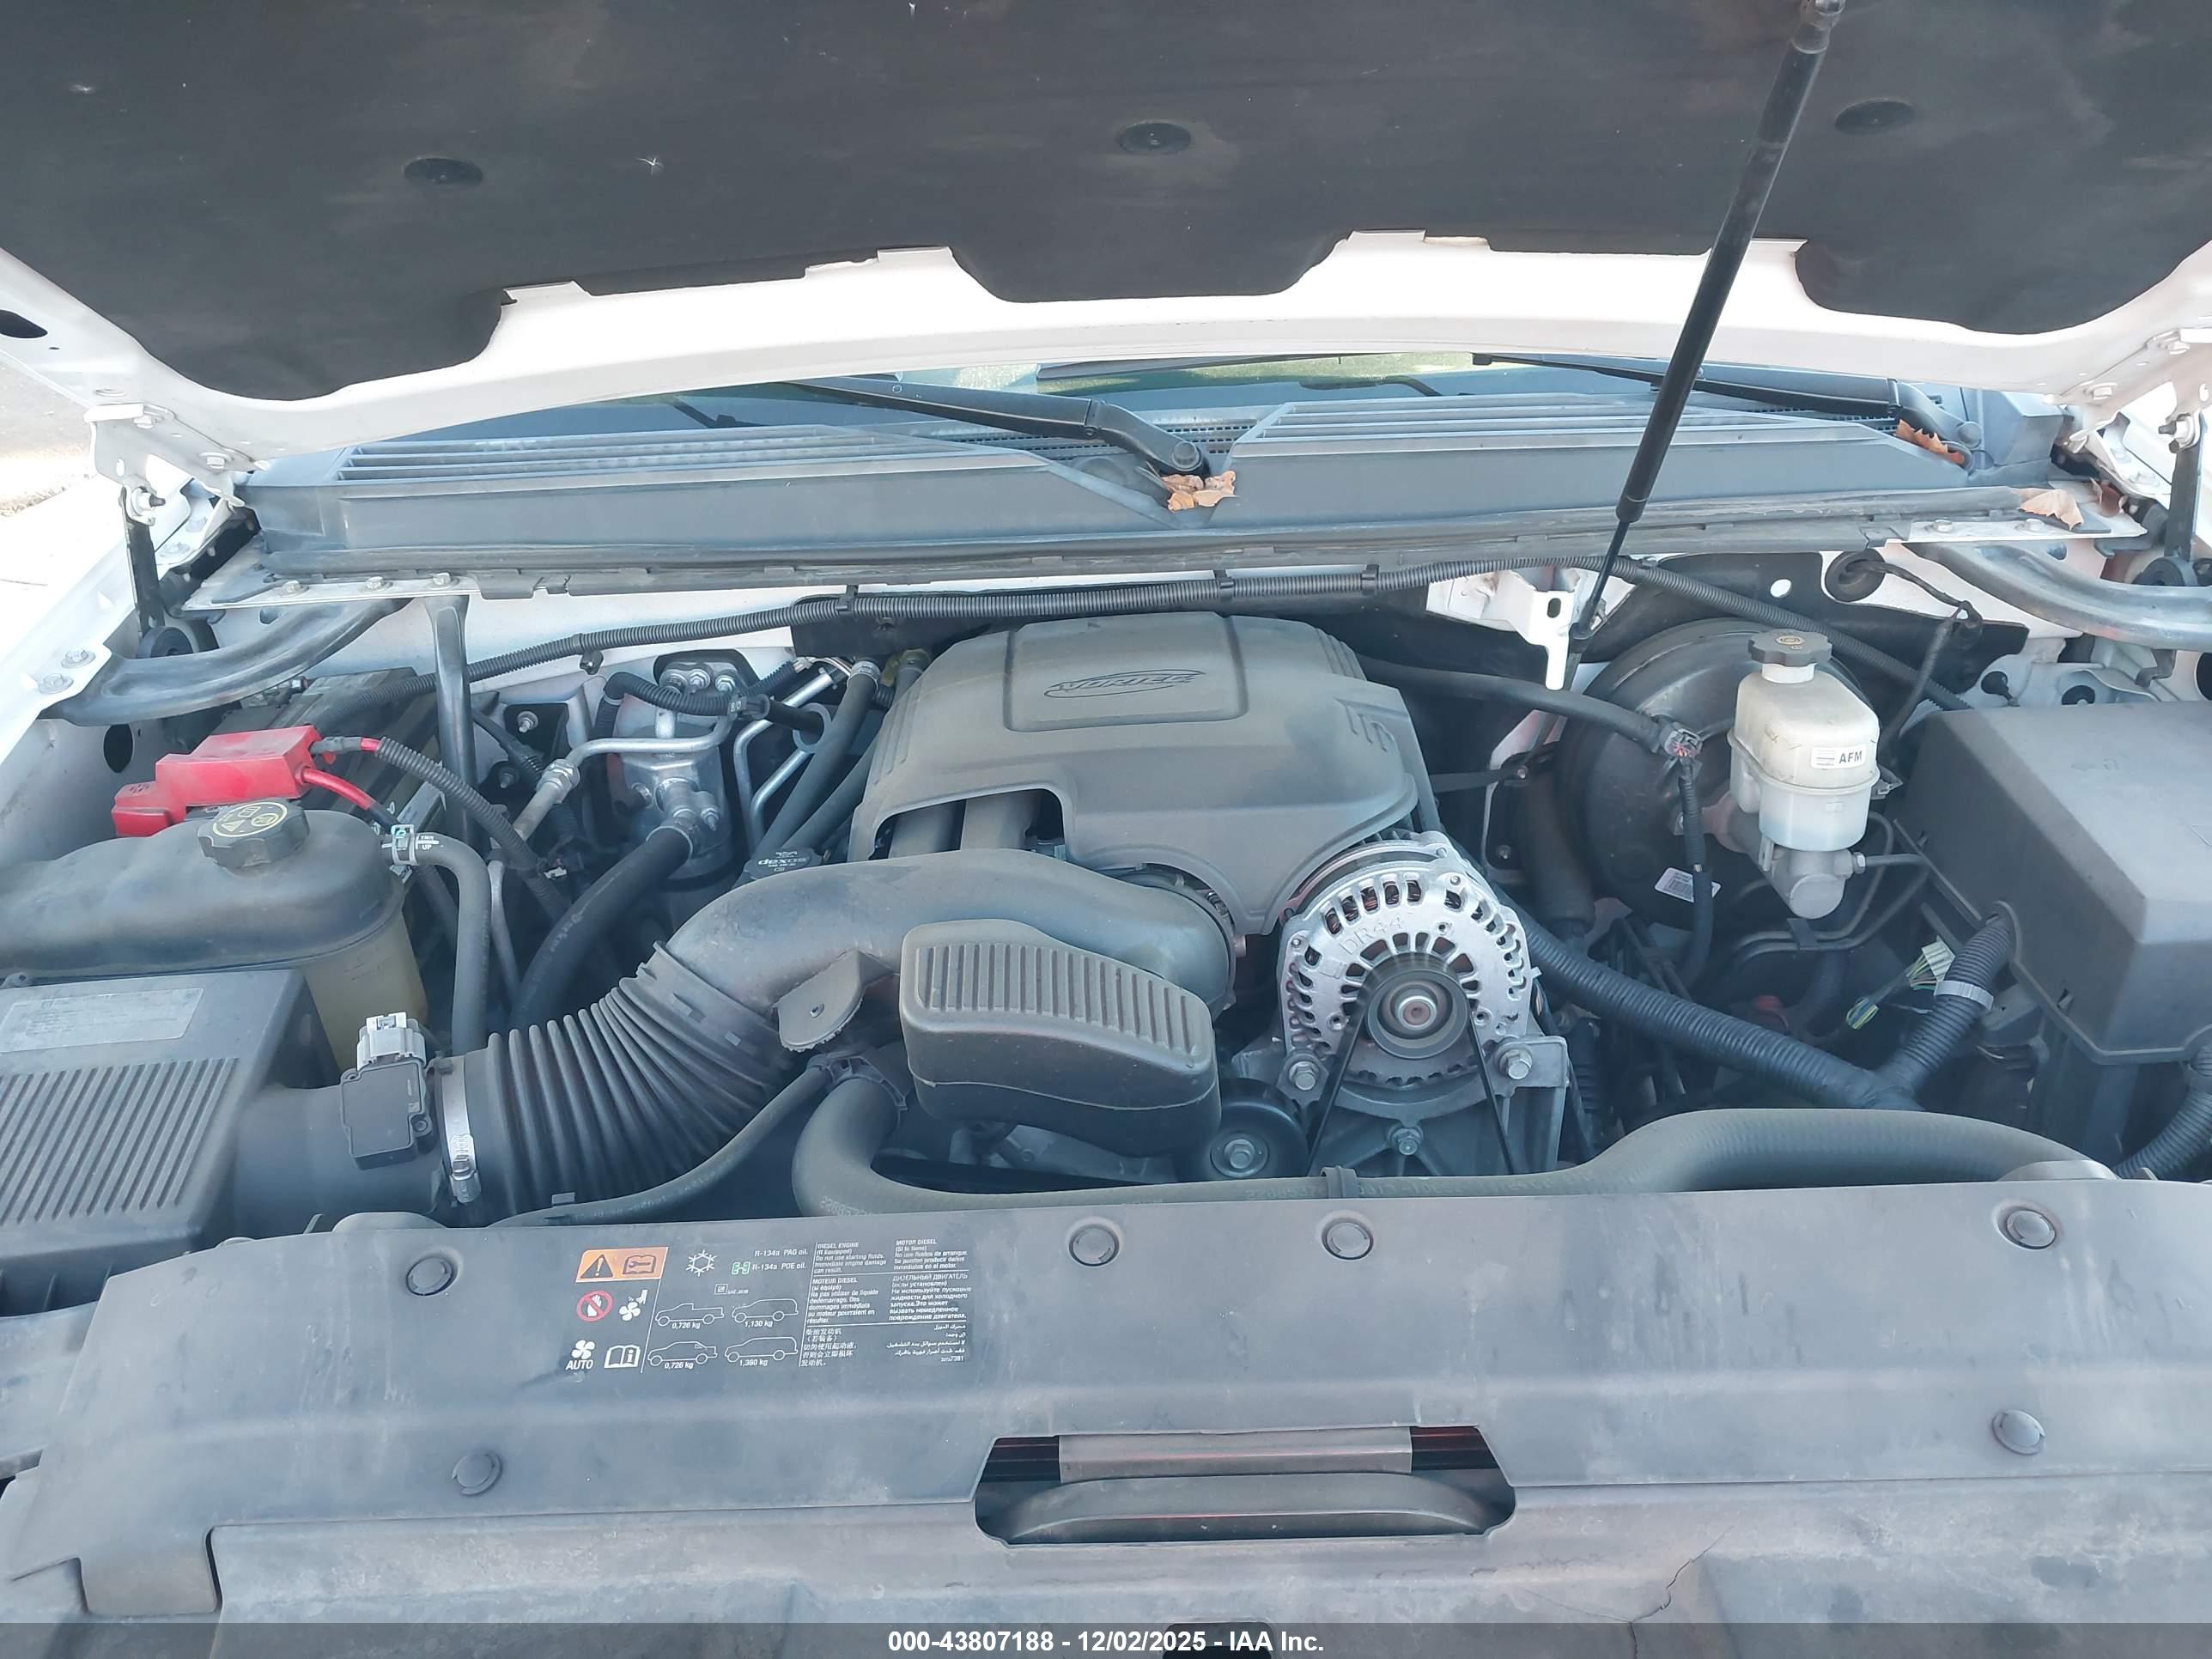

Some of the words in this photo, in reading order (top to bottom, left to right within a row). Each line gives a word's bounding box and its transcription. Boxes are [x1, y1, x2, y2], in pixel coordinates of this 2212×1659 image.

[1838, 750, 1863, 764] AFM
[565, 1359, 593, 1370] AUTO
[685, 1361, 694, 1370] kg
